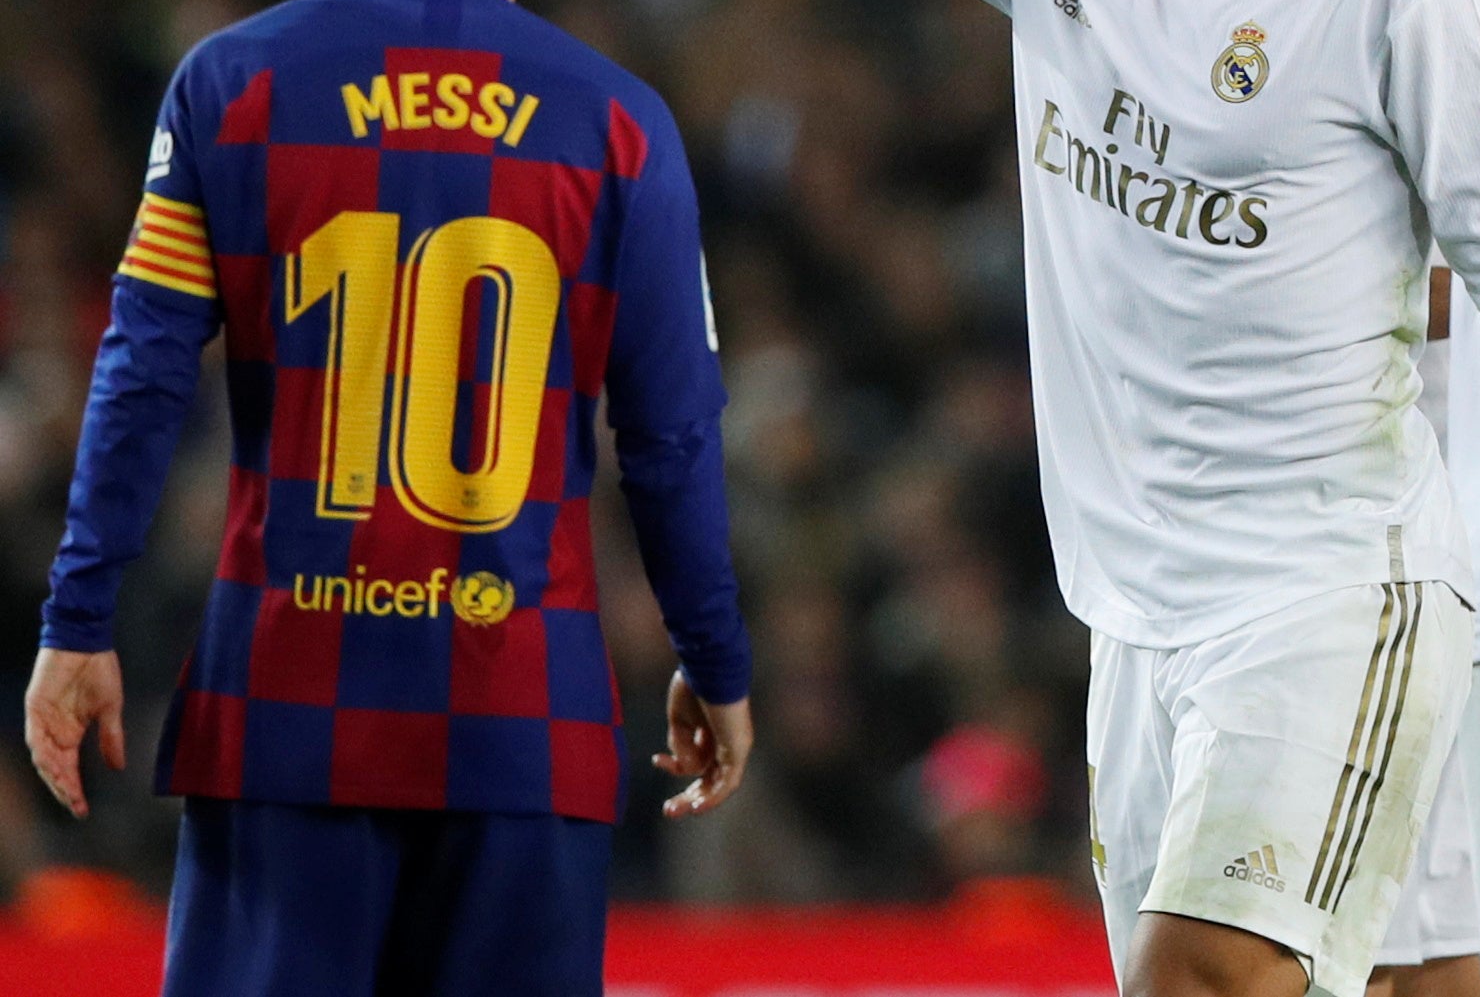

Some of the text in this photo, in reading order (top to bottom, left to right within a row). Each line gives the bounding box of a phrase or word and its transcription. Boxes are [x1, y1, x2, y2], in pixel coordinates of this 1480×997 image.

[341, 72, 540, 148] MESSI
[1103, 88, 1170, 166] Fly
[1034, 99, 1268, 249] Emirates
[285, 210, 560, 533] 10
[294, 565, 448, 618] unicef
[1223, 865, 1286, 893] adidas
